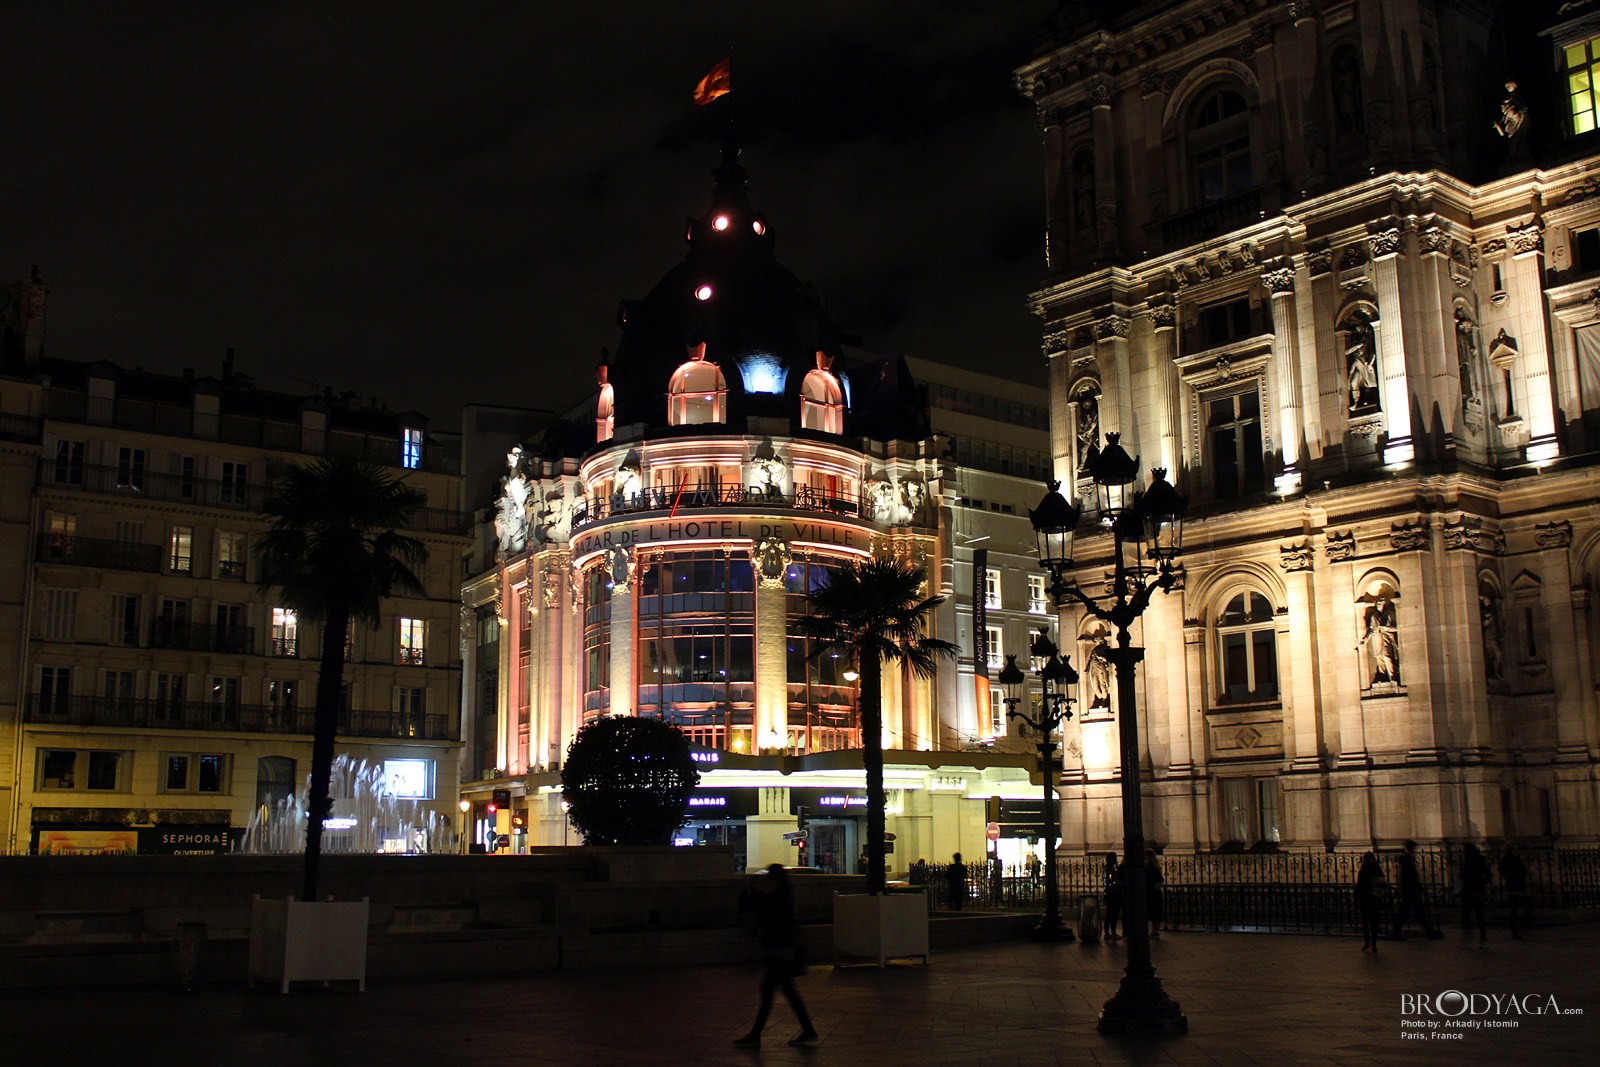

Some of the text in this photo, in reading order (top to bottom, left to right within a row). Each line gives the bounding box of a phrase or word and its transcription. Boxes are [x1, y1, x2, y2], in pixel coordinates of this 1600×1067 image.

[575, 531, 614, 557] BAZAR
[621, 529, 639, 544] DE
[760, 524, 783, 539] DE
[793, 523, 853, 546] VILLE
[976, 635, 984, 662] MODE
[690, 752, 720, 763] RAIS
[688, 797, 727, 806] MARAIS
[162, 834, 220, 844] SEPHORA
